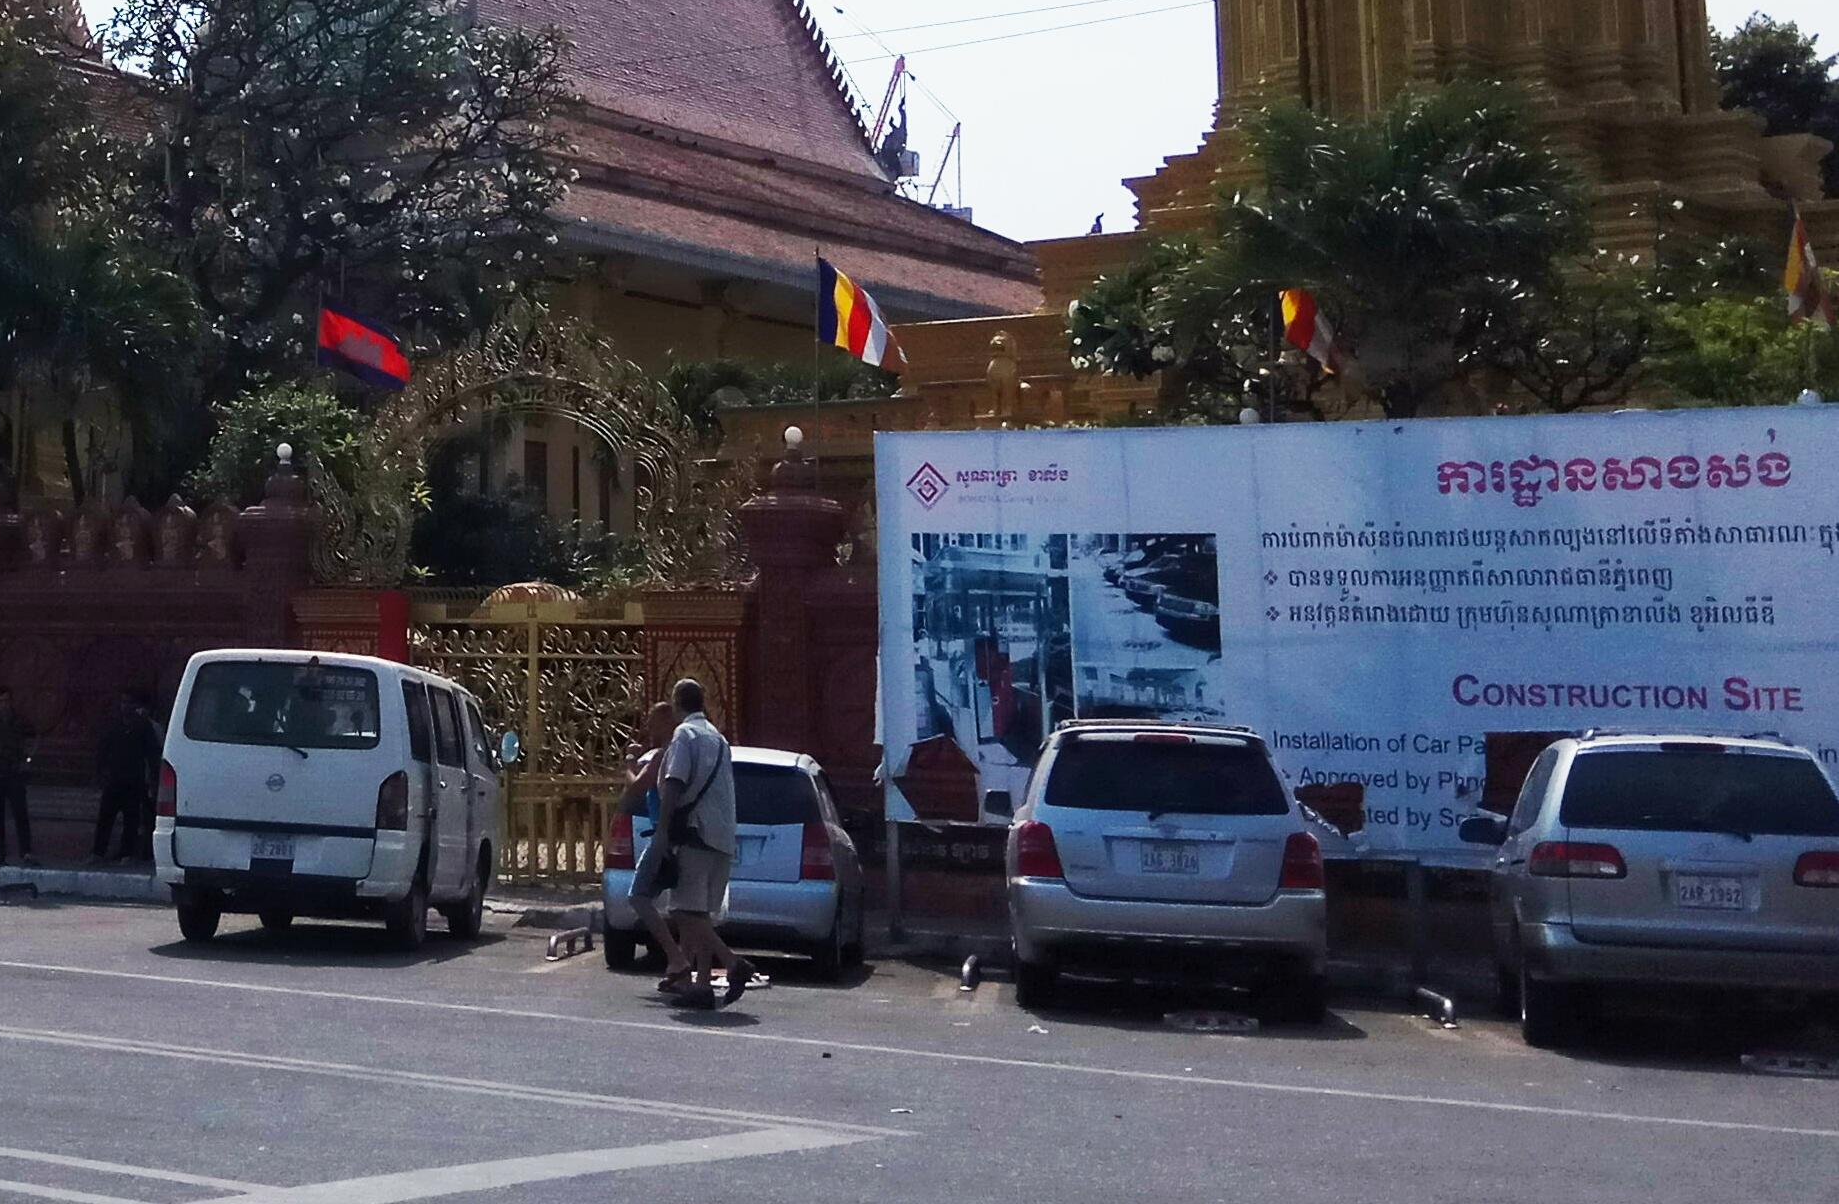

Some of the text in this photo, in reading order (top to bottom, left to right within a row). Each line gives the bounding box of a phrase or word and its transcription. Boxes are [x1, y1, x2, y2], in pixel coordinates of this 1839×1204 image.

[1436, 427, 1792, 507] ការដ្ឋានសាងសង់
[1452, 674, 1804, 712] CONSTRUCTION SITE
[1273, 730, 1380, 752] Installation
[1386, 733, 1408, 753] of
[1413, 734, 1451, 754] Car
[1458, 735, 1486, 755] Pa
[1405, 769, 1430, 794] by
[1406, 808, 1432, 831] by
